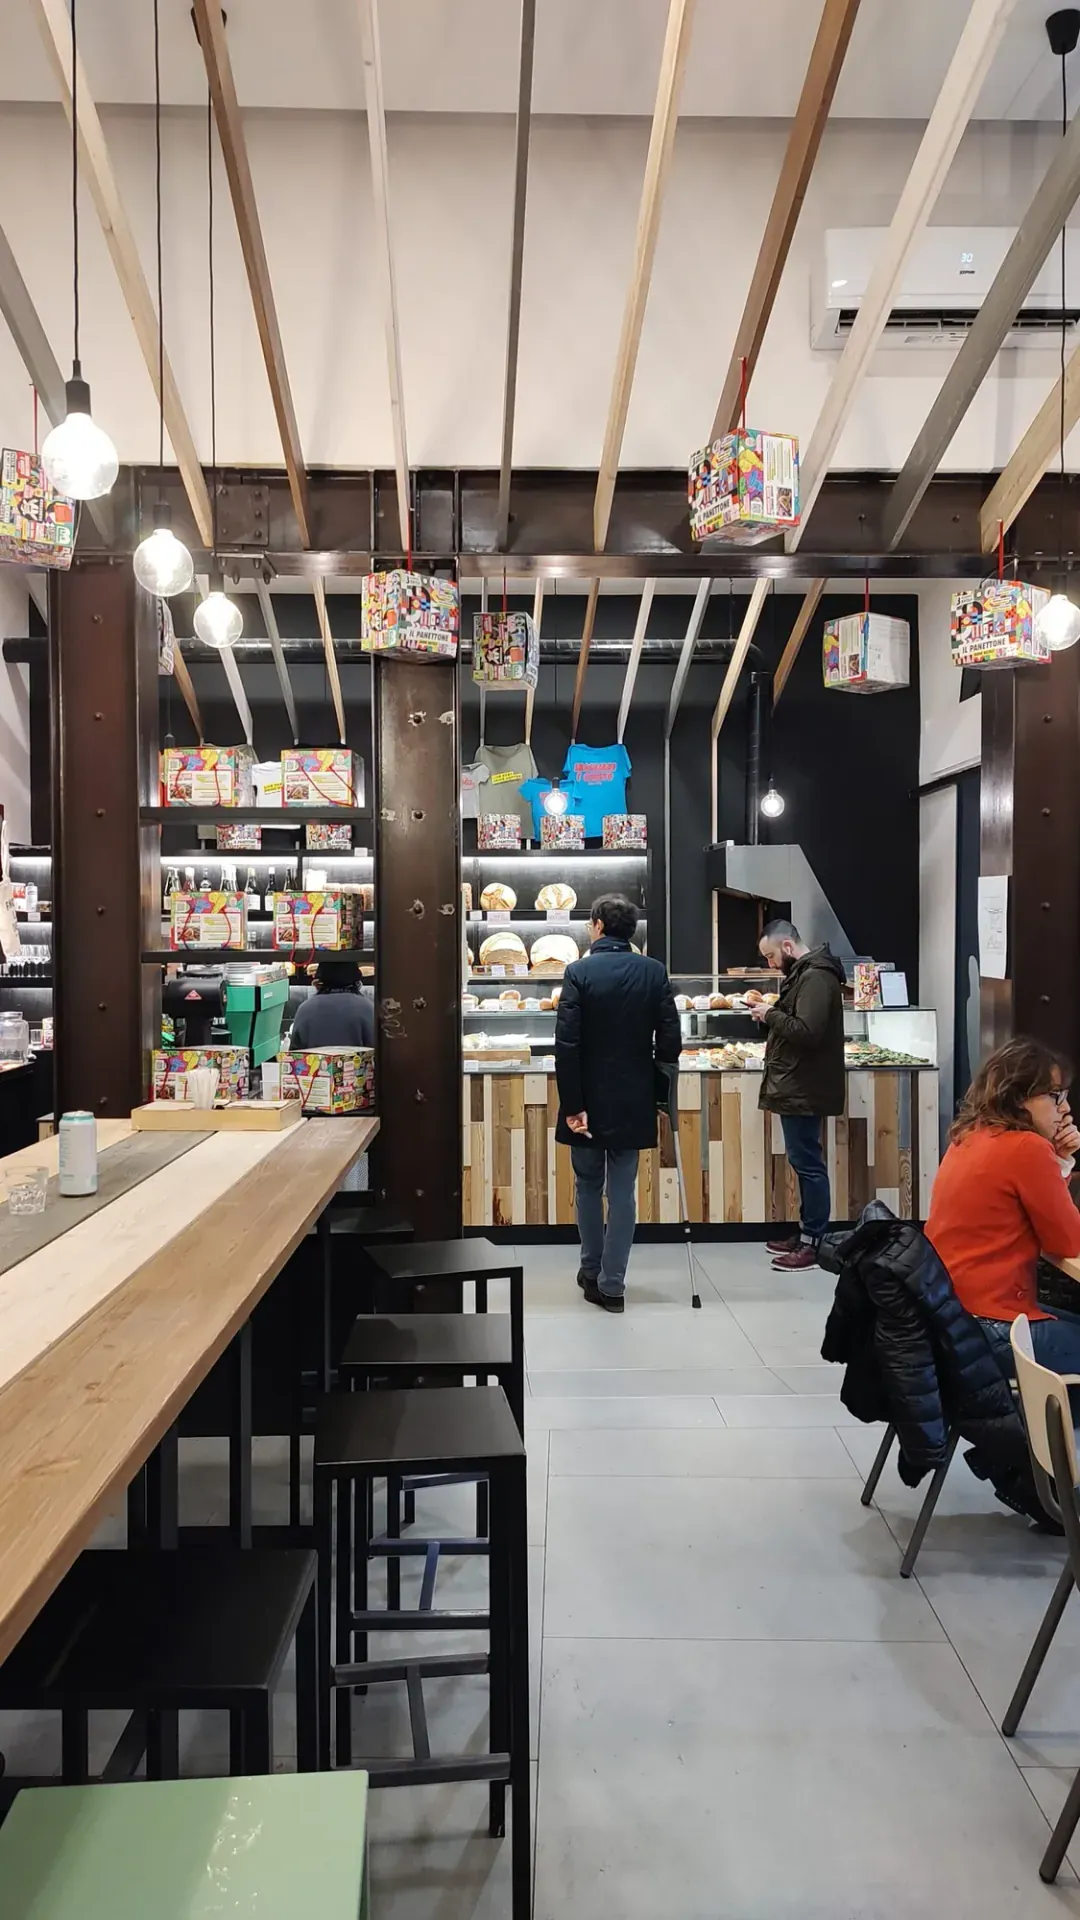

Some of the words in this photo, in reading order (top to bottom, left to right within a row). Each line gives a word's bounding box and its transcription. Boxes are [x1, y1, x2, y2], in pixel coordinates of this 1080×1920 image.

[961, 252, 973, 263] 30
[703, 499, 730, 519] PANETTONE
[416, 630, 449, 641] PANETTONE
[970, 637, 1006, 652] PANETTONE
